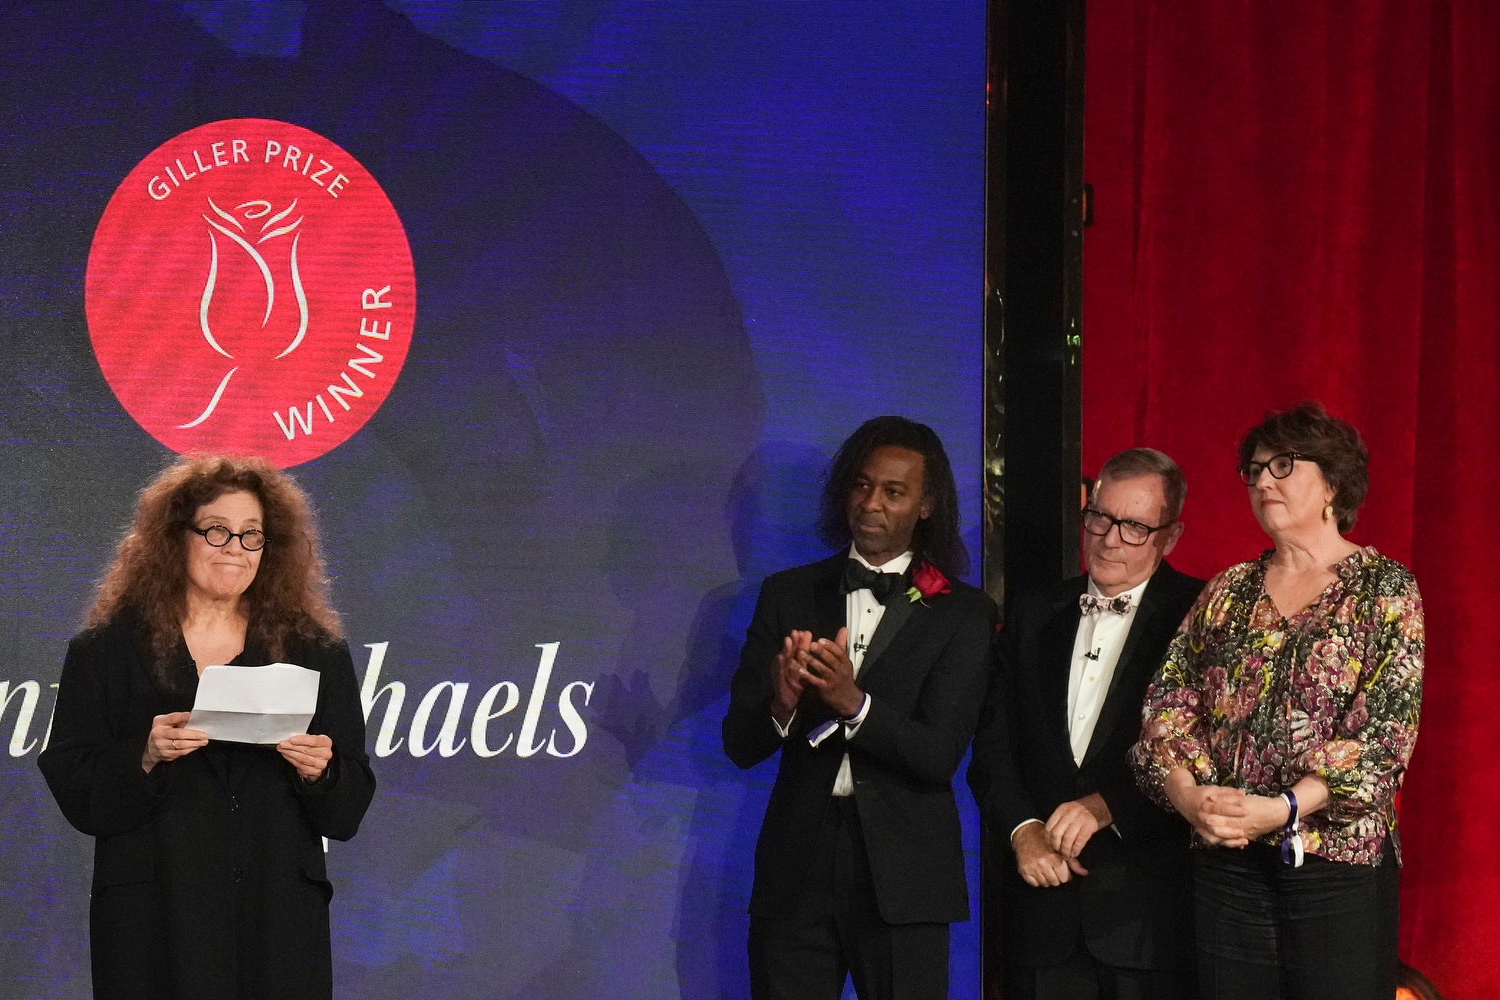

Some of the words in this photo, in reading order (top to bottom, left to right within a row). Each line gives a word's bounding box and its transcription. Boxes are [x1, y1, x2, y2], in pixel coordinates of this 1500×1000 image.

[147, 139, 250, 200] GILLER
[264, 140, 350, 199] PRIZE
[272, 285, 393, 441] WINNER
[360, 641, 596, 758] haels
